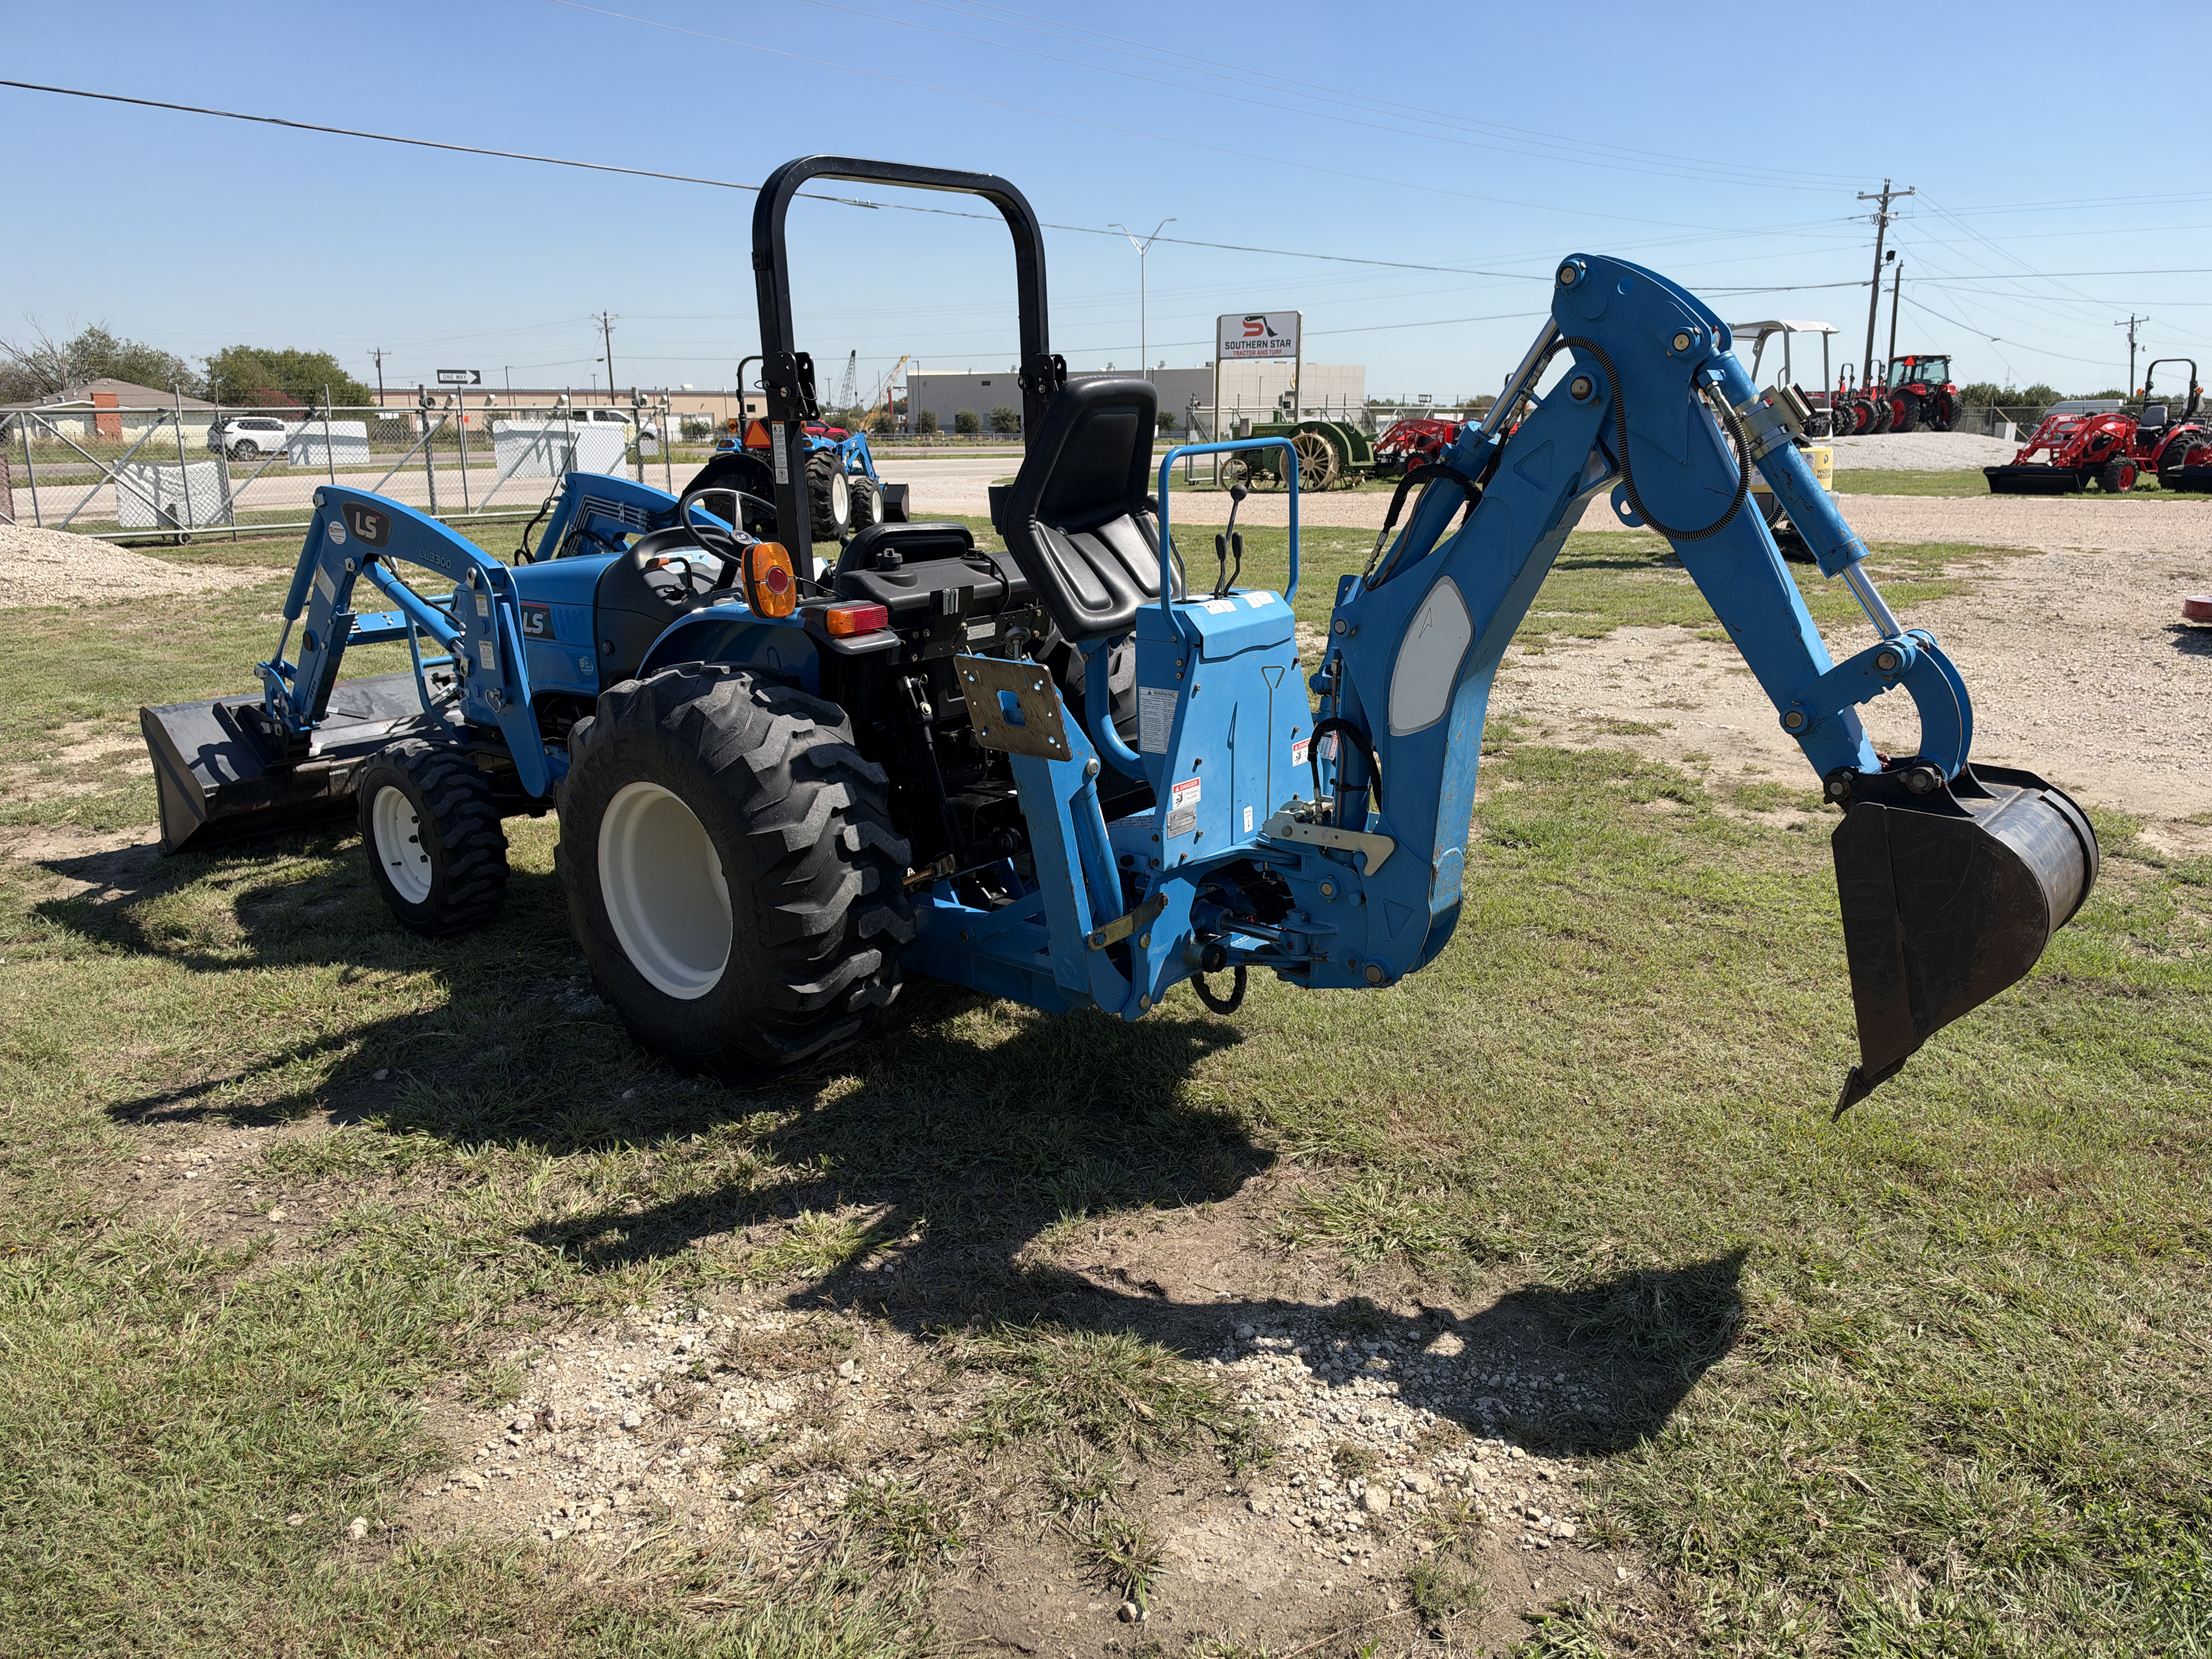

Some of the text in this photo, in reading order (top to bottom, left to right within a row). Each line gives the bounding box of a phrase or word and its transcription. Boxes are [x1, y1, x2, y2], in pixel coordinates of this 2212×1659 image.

[1225, 339, 1291, 350] SOUTHERN STAR
[355, 511, 377, 539] LS
[419, 547, 452, 570] LL3300
[523, 612, 544, 634] LS
[1298, 739, 1311, 749] DANGE
[1180, 780, 1197, 790] DANGER
